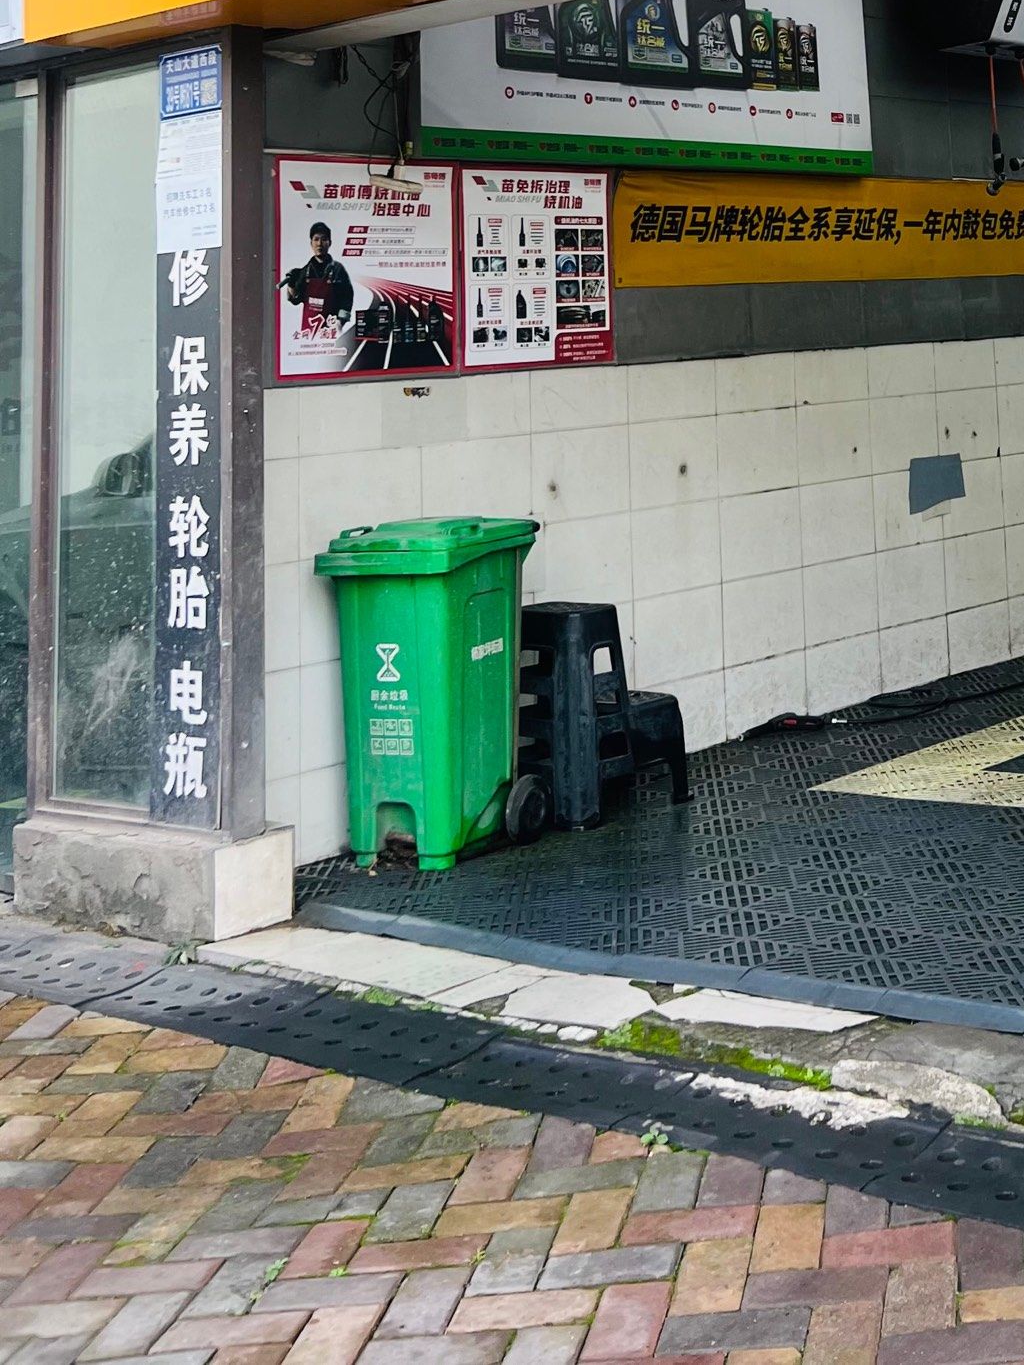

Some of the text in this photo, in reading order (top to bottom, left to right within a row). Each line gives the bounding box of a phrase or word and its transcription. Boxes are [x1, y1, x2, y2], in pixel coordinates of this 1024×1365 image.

[372, 202, 431, 218] 治理中心
[501, 179, 571, 194] 苗免拆治理
[543, 195, 583, 210] 烧机油
[168, 249, 209, 307] 修
[168, 334, 210, 467] 保养
[168, 493, 210, 631] 轮胎
[162, 660, 209, 800] 电瓶
